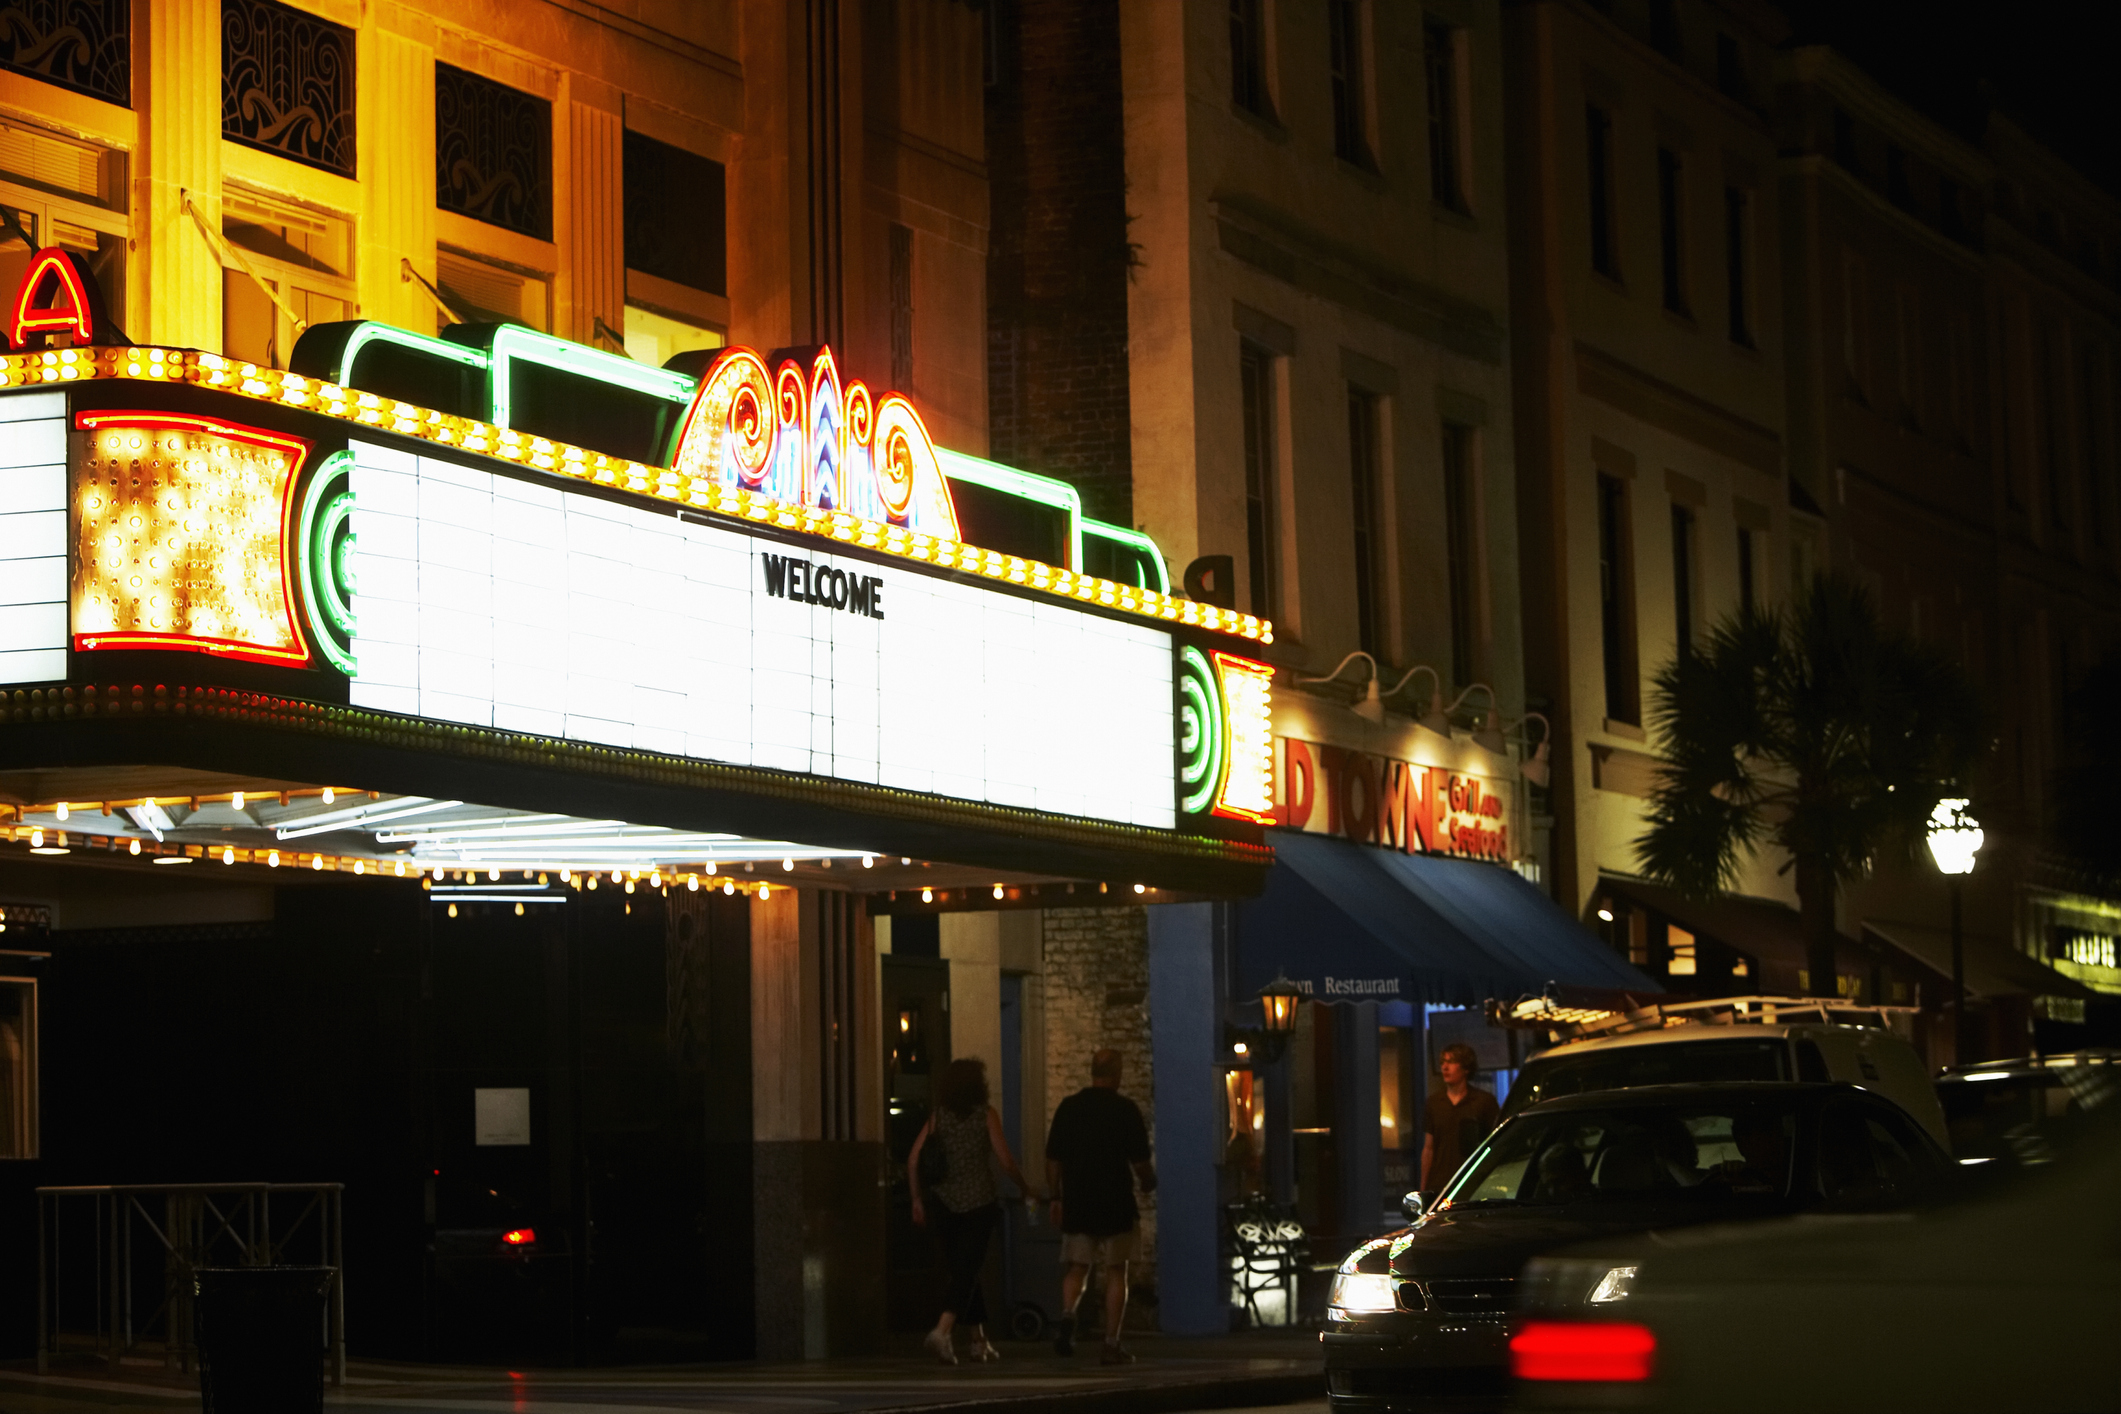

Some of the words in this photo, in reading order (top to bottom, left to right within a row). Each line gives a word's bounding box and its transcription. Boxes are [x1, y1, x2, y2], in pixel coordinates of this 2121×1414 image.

[9, 247, 93, 350] A
[762, 552, 885, 620] WELCOME
[1320, 743, 1450, 854] TOWNE
[1449, 774, 1480, 815] Grill
[1449, 816, 1508, 860] Seafood
[1325, 976, 1400, 994] Restaurant
